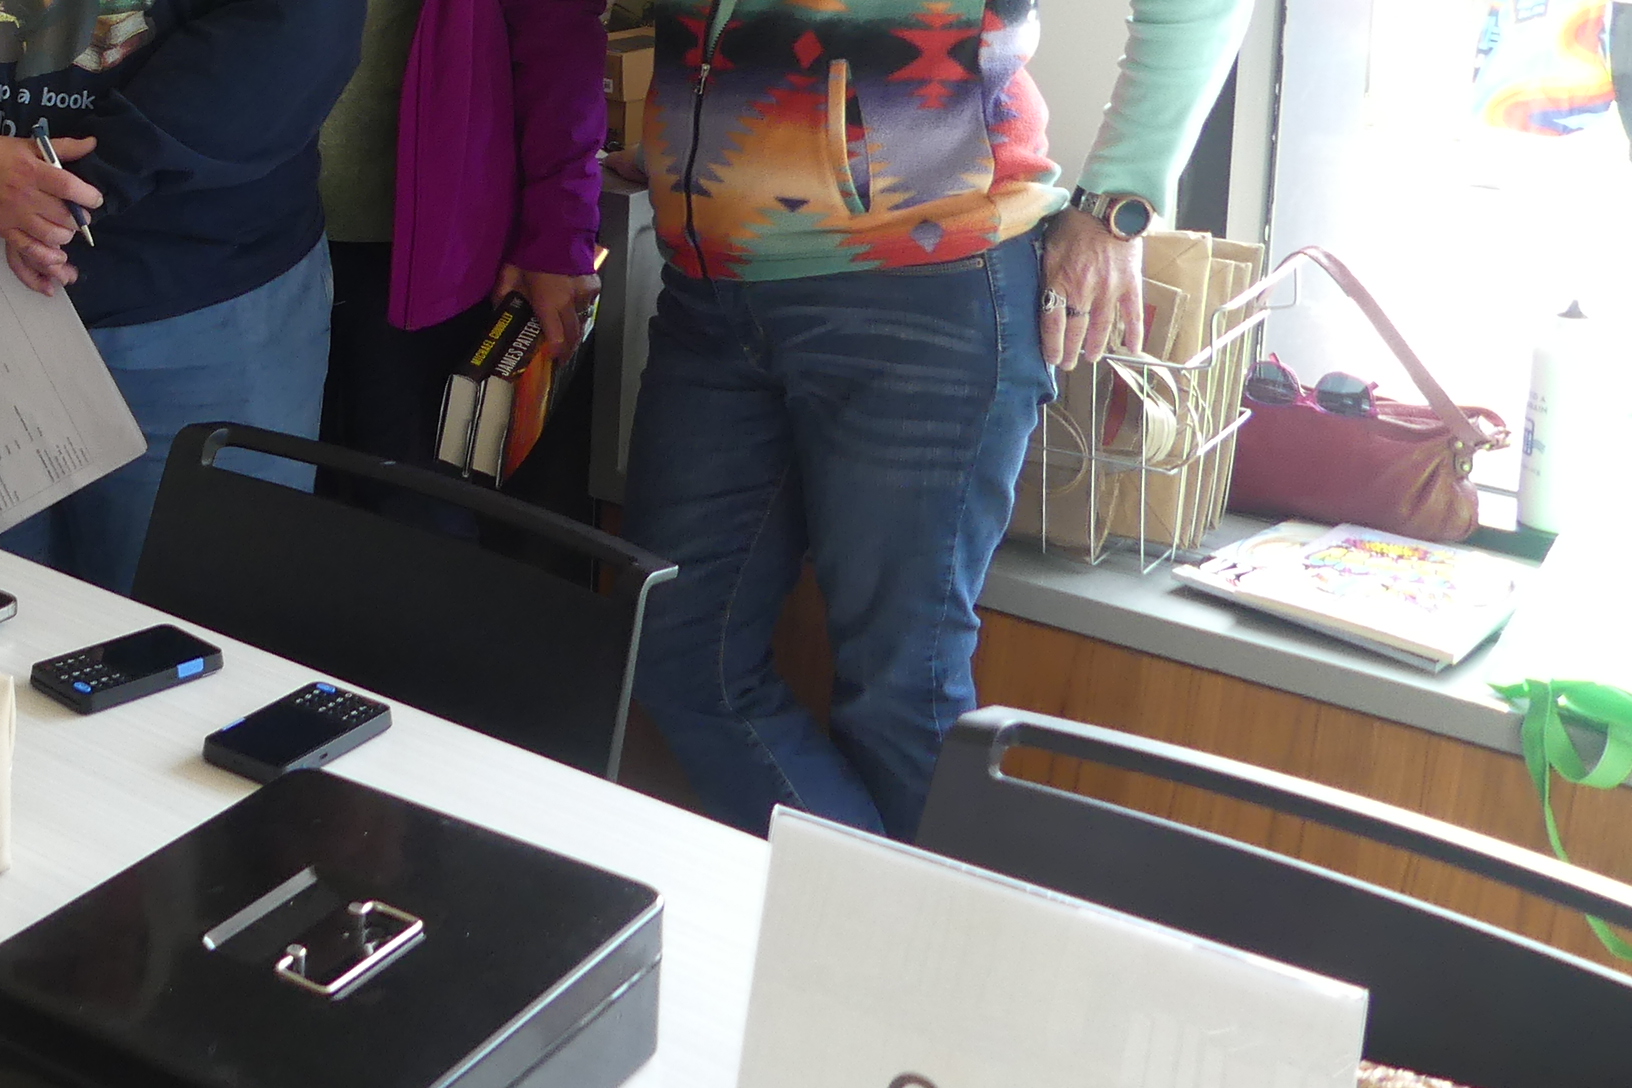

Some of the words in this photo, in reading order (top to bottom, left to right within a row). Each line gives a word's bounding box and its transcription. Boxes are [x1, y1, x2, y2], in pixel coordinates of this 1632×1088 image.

[18, 88, 31, 104] a
[41, 86, 96, 110] book
[495, 348, 524, 377] JAMES
